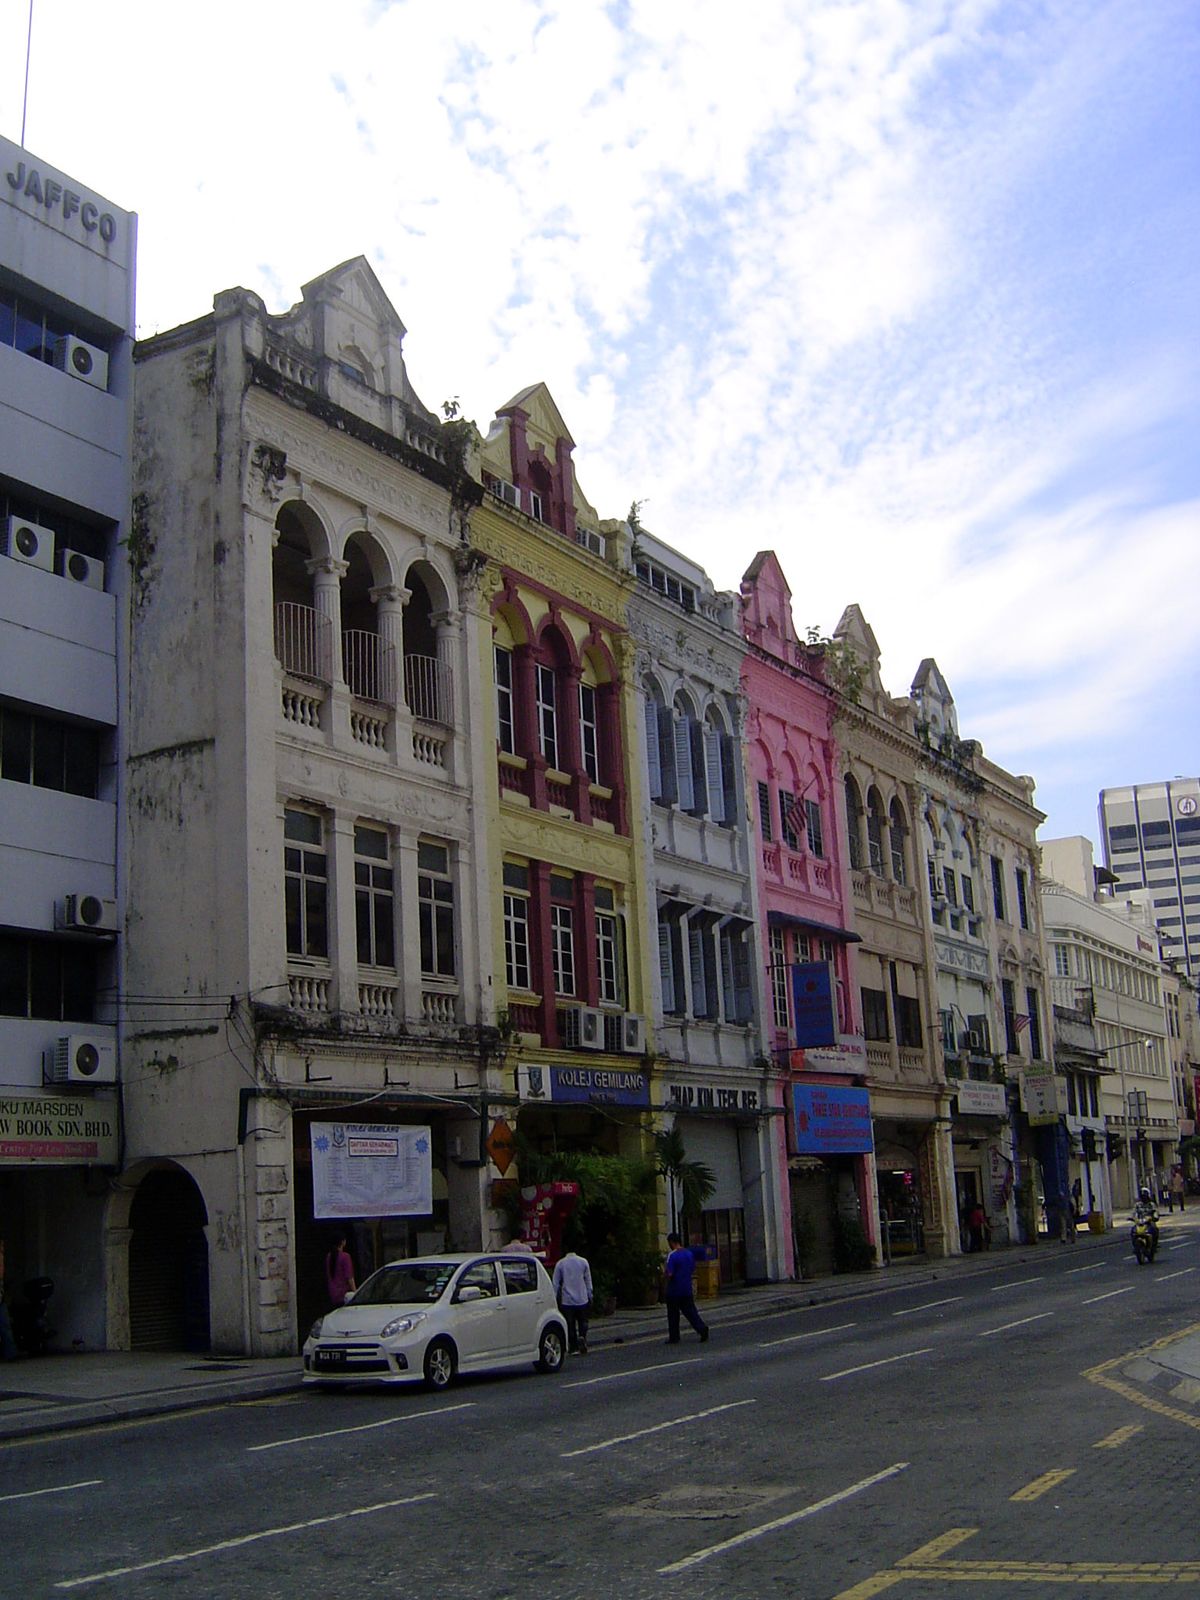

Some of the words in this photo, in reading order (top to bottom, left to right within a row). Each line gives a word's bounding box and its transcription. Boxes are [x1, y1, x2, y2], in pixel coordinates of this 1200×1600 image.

[7, 162, 116, 243] JAFFCO
[558, 1070, 591, 1087] KOLEJ
[594, 1072, 643, 1090] GEMILANG
[0, 1100, 19, 1115] KU
[23, 1102, 84, 1117] MARSDEN
[17, 1119, 53, 1136] BOOK
